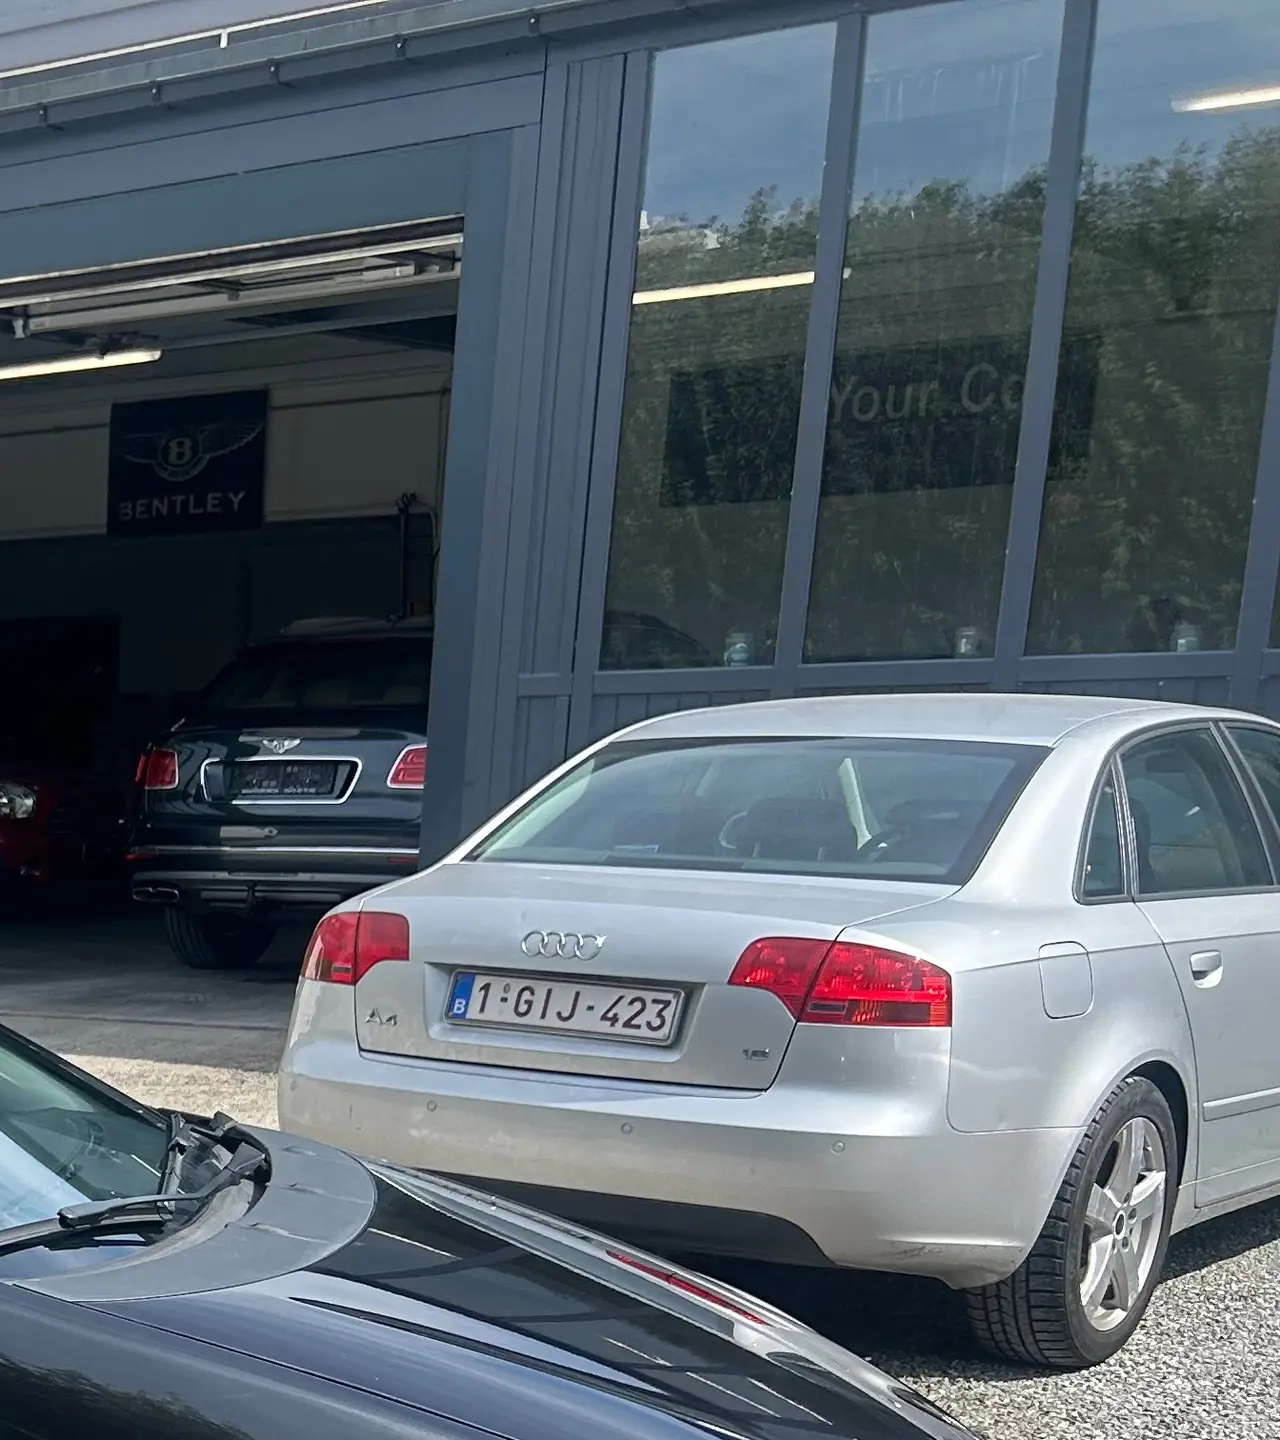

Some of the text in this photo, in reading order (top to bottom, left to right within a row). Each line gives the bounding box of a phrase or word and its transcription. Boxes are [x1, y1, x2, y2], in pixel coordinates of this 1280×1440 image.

[830, 374, 939, 423] Your
[119, 490, 246, 522] BENTLEY
[452, 981, 672, 1032] B 1-GIJ-423
